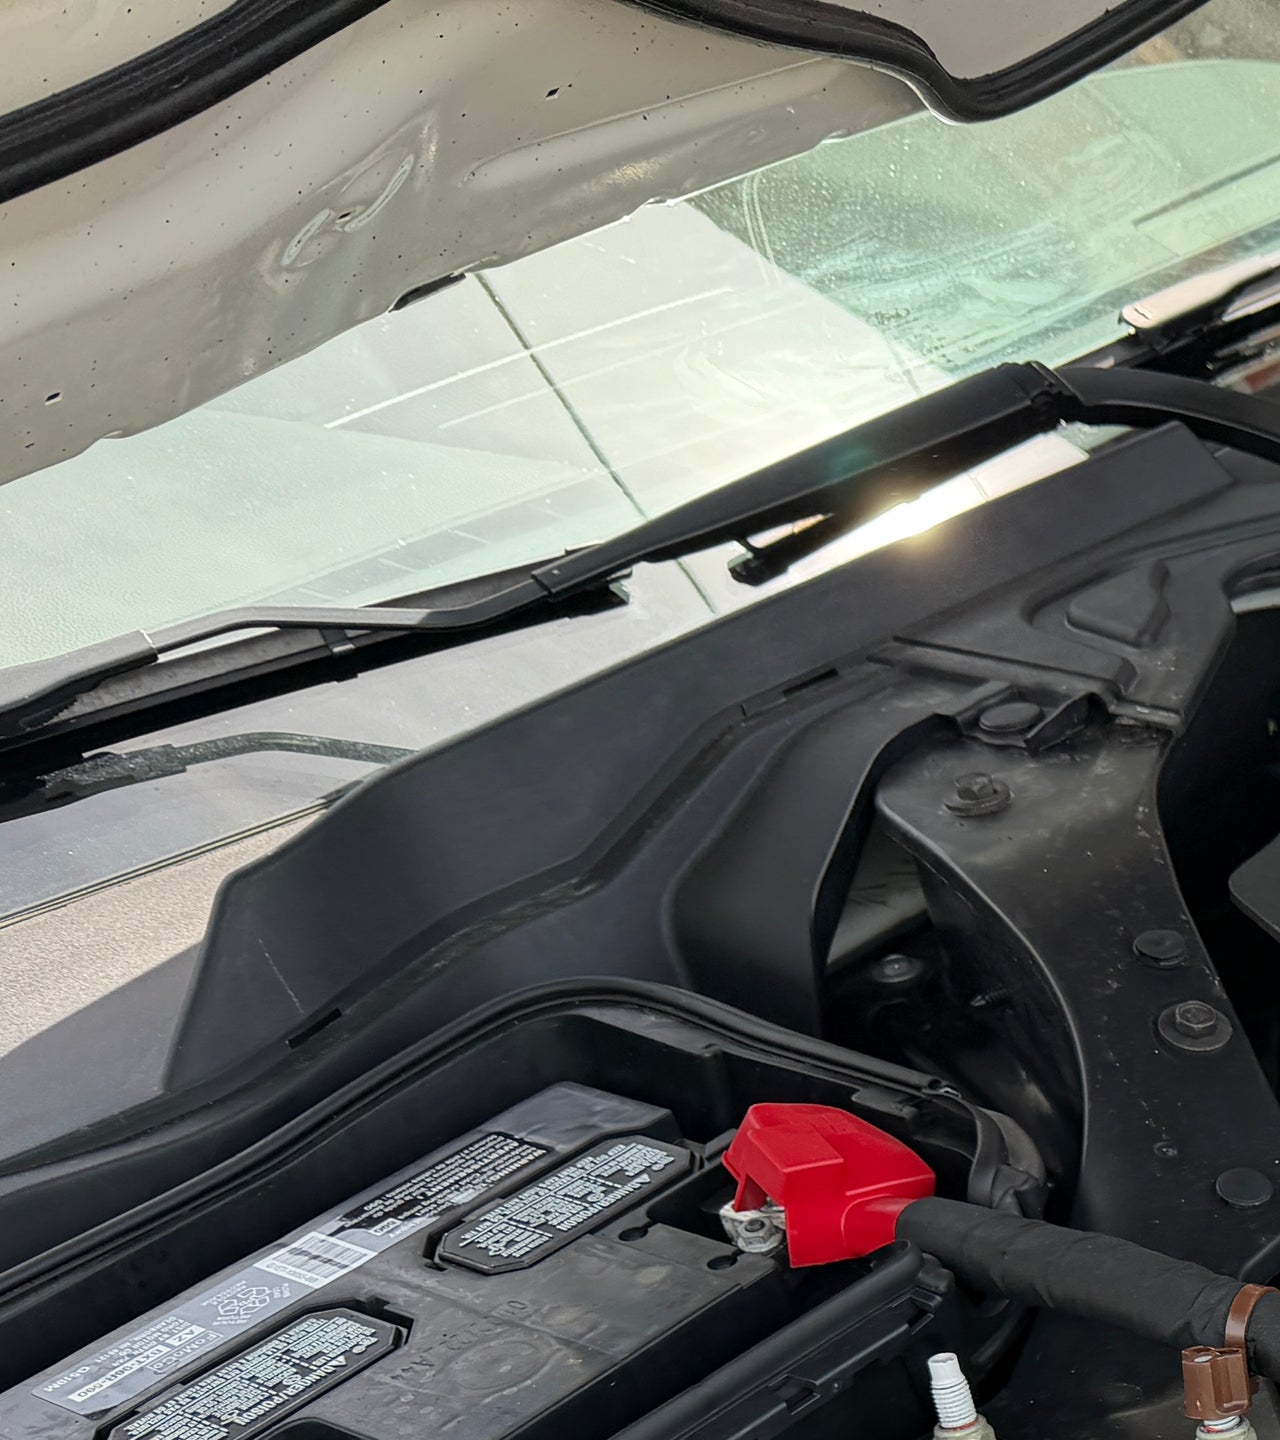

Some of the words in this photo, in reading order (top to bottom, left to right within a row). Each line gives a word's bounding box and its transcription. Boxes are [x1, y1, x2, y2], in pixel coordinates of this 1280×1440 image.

[150, 1332, 217, 1370] FoMoCo
[171, 1328, 197, 1342] AZ
[229, 1363, 337, 1426] DANGER/POISON
